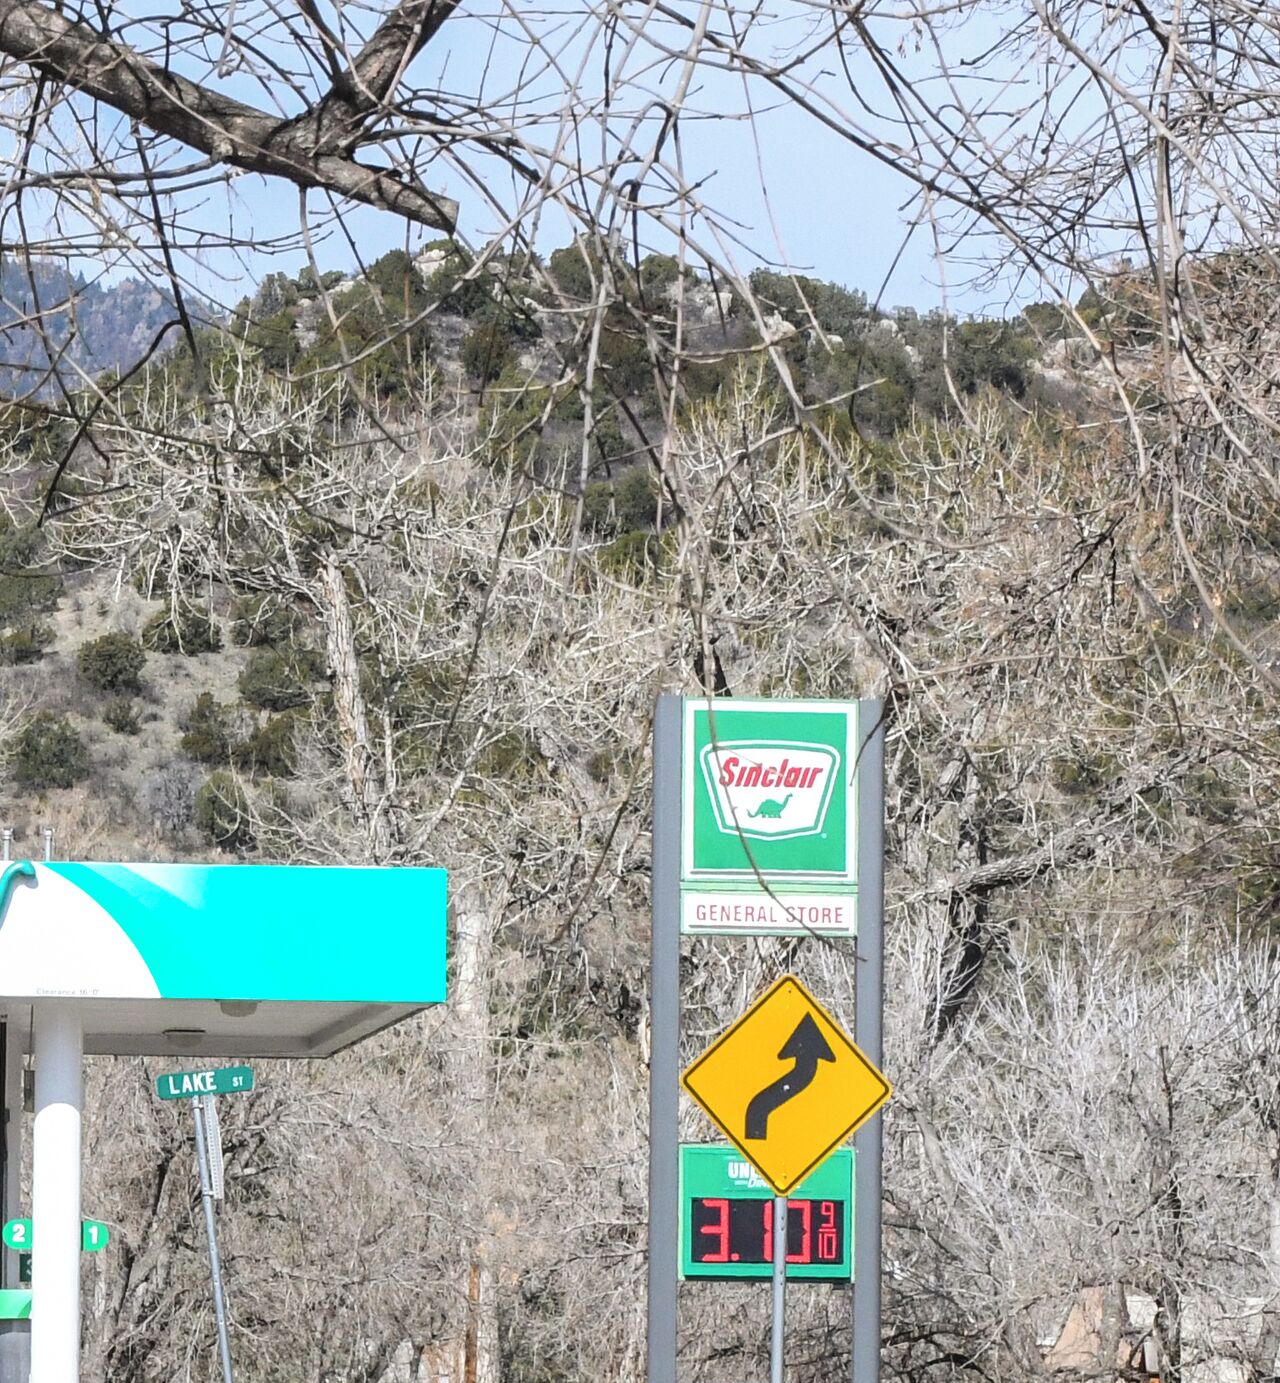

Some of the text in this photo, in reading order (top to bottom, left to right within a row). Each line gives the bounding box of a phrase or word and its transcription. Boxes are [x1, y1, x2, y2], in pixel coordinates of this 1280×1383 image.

[719, 757, 823, 788] Sinclair
[696, 905, 843, 923] GENERAL STORE
[168, 1071, 243, 1095] LAKE ST
[12, 1223, 25, 1243] 2
[88, 1225, 99, 1245] 1
